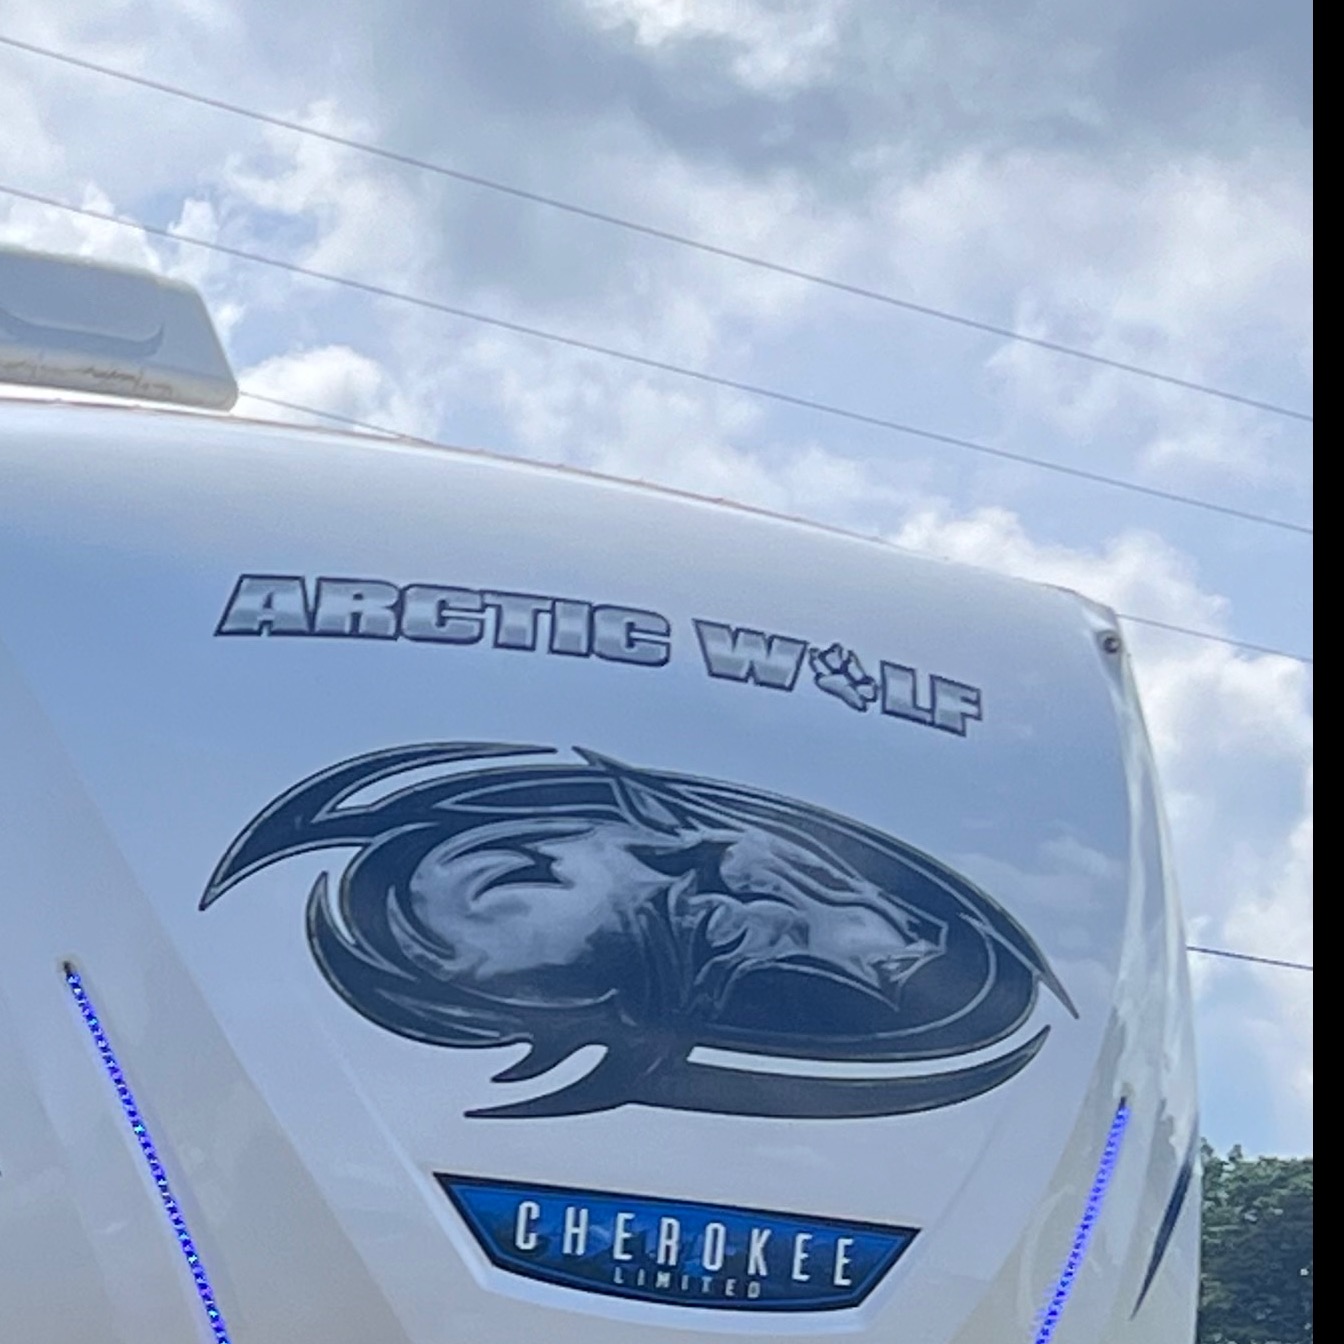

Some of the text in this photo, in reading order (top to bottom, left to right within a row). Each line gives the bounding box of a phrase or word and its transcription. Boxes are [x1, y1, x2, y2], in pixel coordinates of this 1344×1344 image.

[214, 573, 672, 668] ARCTIC
[514, 1200, 855, 1287] CHEROKEE
[613, 1266, 761, 1299] LIMITED
